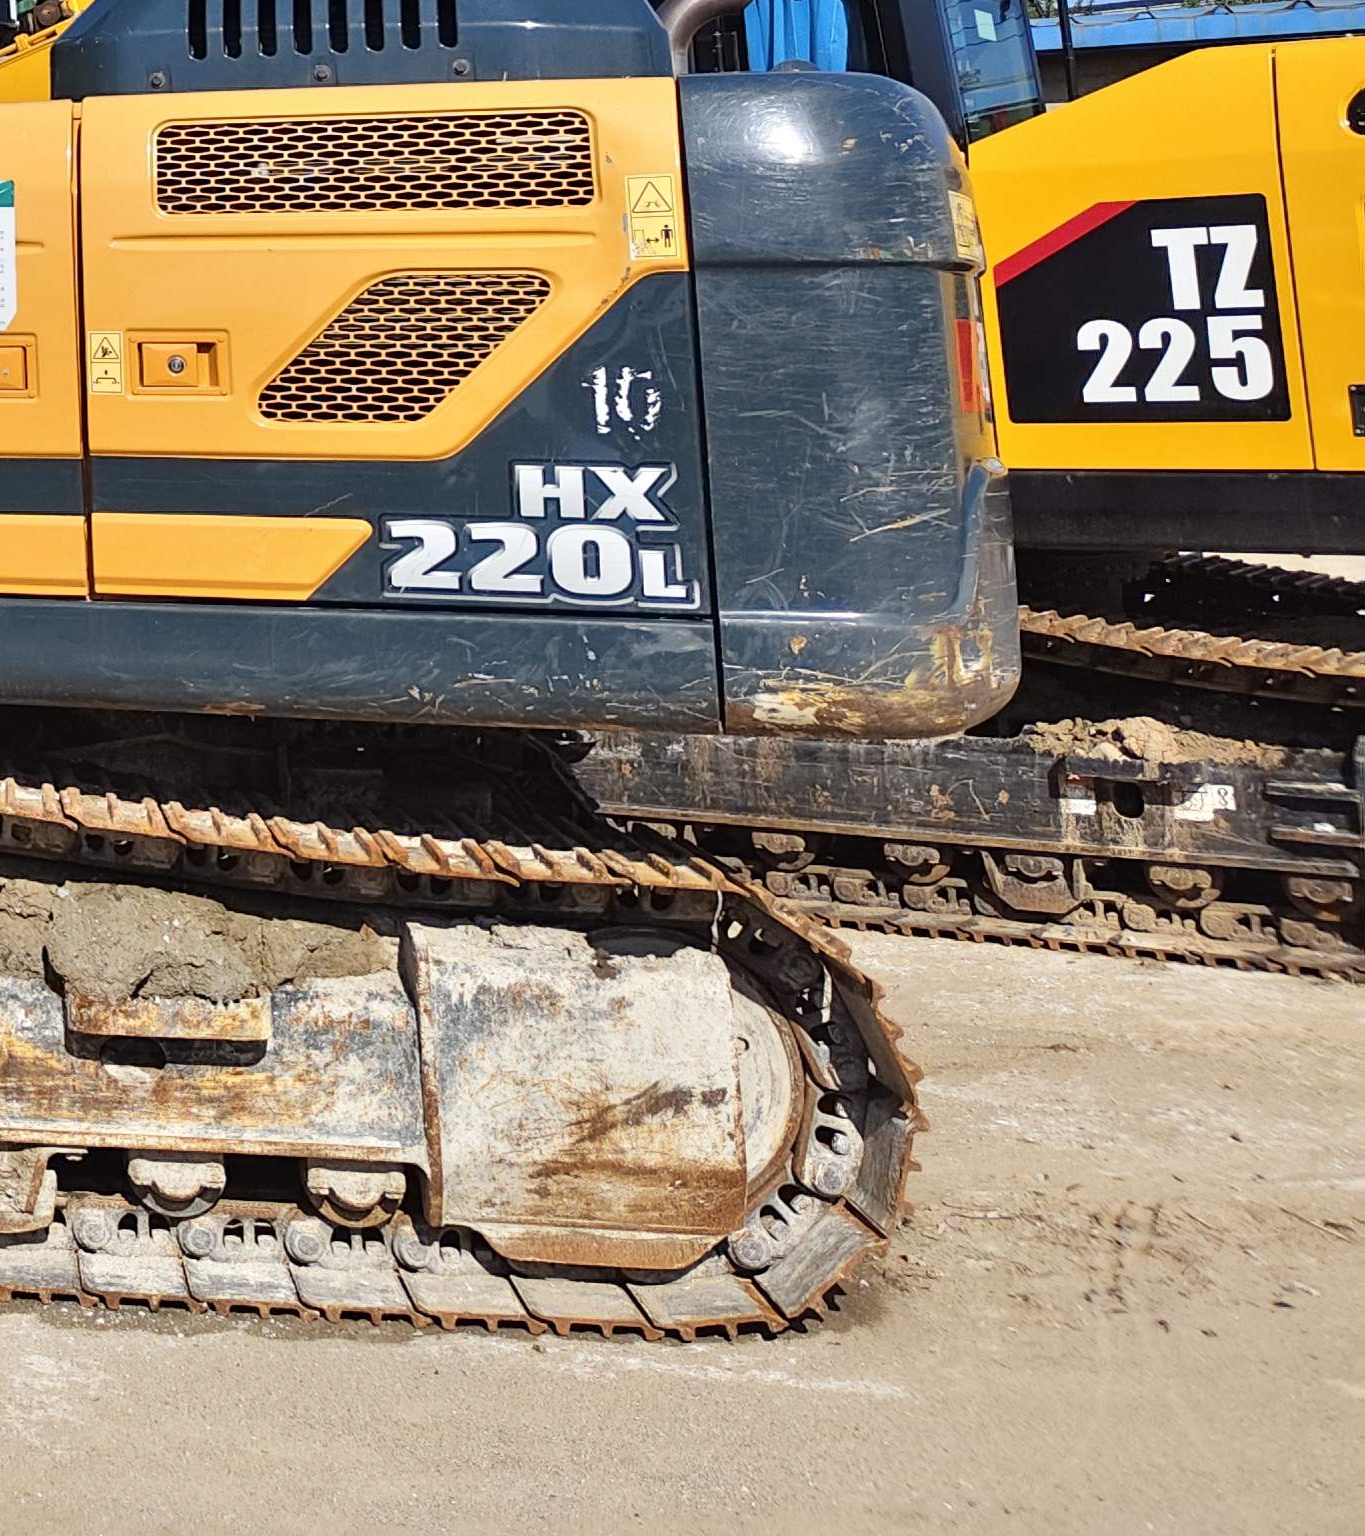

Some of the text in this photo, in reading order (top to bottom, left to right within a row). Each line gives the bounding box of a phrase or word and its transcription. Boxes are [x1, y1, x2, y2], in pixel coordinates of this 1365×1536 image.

[1150, 224, 1265, 310] TZ
[1077, 314, 1274, 403] 225
[514, 464, 670, 522] HX
[384, 519, 688, 598] 220L
